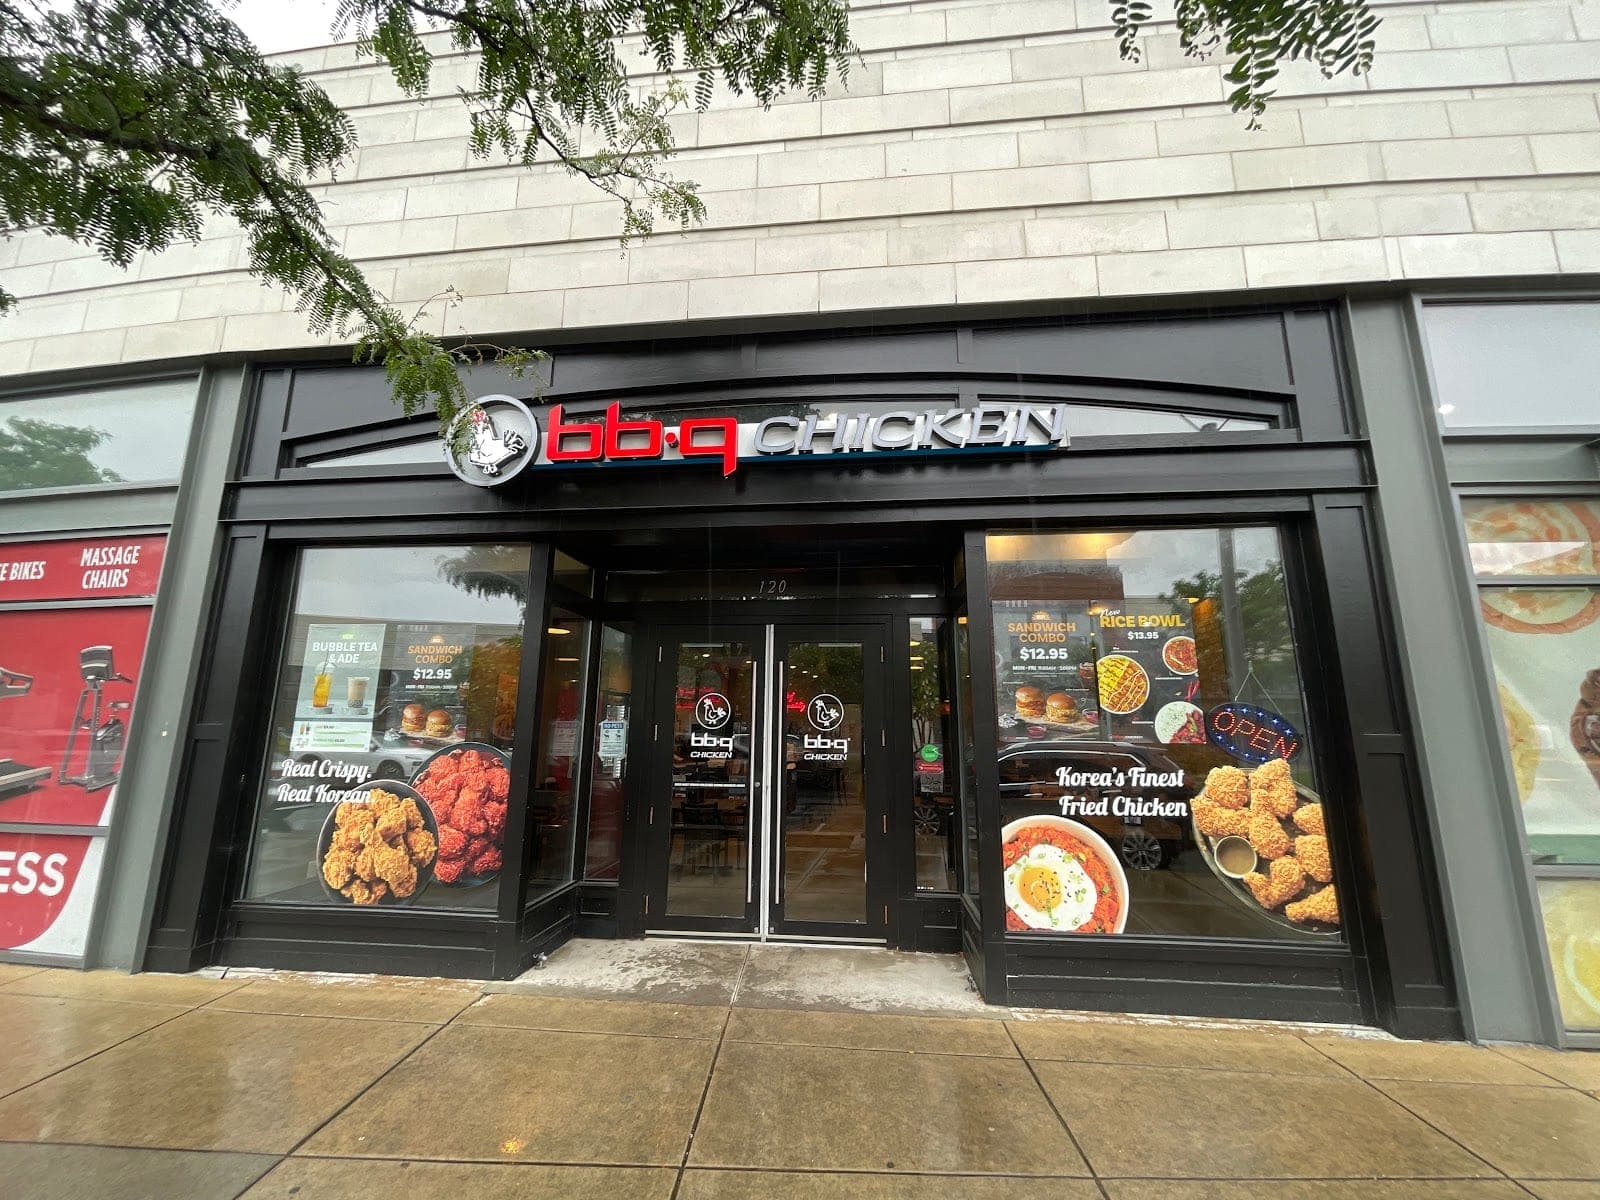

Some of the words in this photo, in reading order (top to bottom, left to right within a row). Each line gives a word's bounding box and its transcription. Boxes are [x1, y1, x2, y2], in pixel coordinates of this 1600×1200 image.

[753, 403, 1066, 454] CHICKEN
[80, 545, 141, 567] MASSAGE
[0, 562, 9, 581] E
[9, 561, 46, 581] BIKES
[81, 568, 130, 589] CHAIRS
[759, 579, 787, 594] 120
[1007, 622, 1077, 633] SANDWICH
[1100, 615, 1136, 628] RICE
[1138, 614, 1186, 628] BOWL
[1019, 632, 1067, 643] COMBO
[1127, 630, 1160, 641] $13.95
[312, 641, 357, 652] BUBBLE
[358, 641, 378, 652] TEA
[407, 645, 463, 654] SANDWICH
[1019, 646, 1069, 661] $12.95
[328, 653, 337, 663] &
[337, 653, 361, 664] ADE
[415, 655, 453, 664] COMBO
[413, 668, 453, 680] $12.95
[1214, 711, 1298, 760] OPEN
[690, 751, 733, 759] CHICKEN
[803, 753, 848, 761] CHICKEN
[281, 758, 319, 778] Real
[319, 759, 372, 784] Crispy.
[1055, 766, 1125, 787] Korea's
[1127, 767, 1185, 787] Finest
[277, 783, 315, 802] Real
[1058, 795, 1109, 816] Fried
[1112, 796, 1188, 817] Chicken
